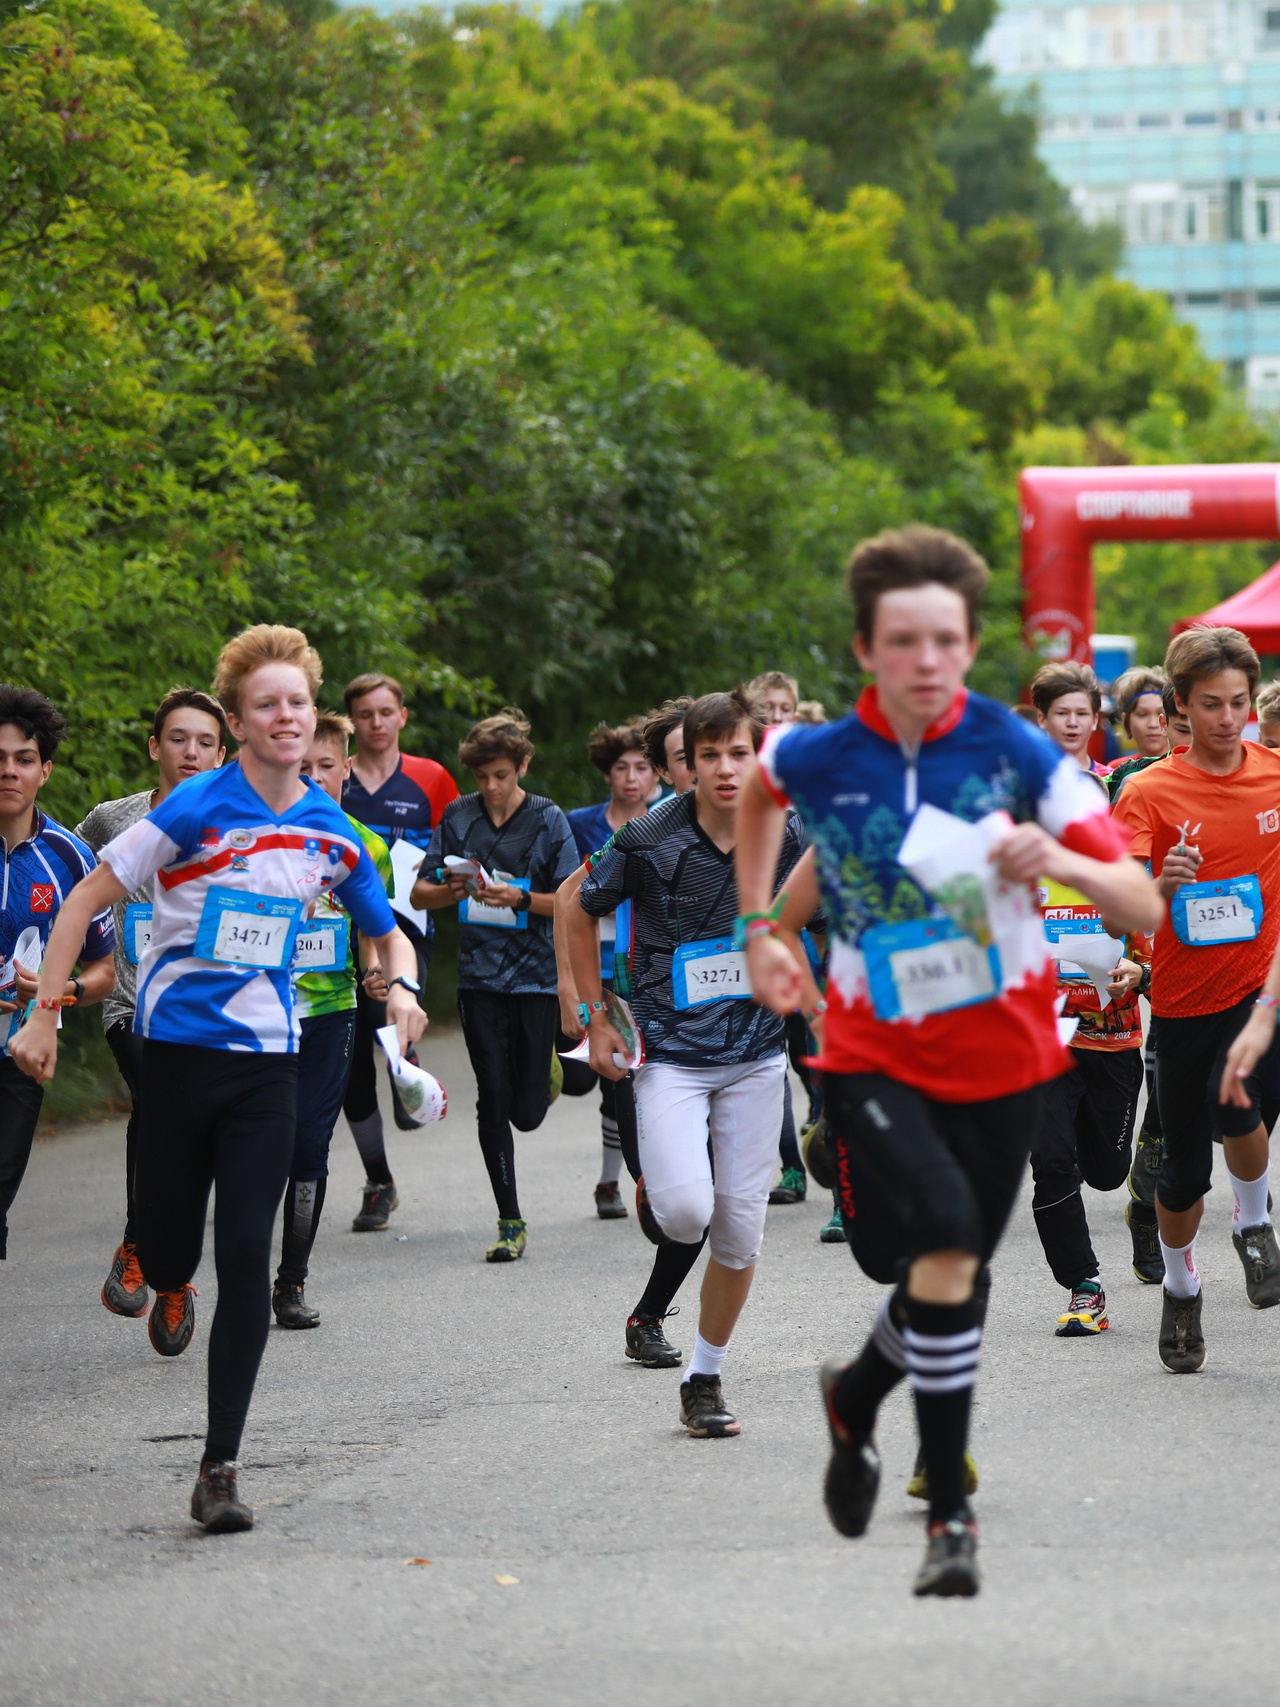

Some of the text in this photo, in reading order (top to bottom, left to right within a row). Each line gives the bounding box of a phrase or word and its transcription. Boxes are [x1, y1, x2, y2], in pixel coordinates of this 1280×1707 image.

[1256, 809, 1280, 835] 10
[1198, 904, 1239, 923] 325.1
[228, 926, 272, 946] 347.1
[298, 939, 323, 951] 20.1
[700, 969, 742, 985] 327.1
